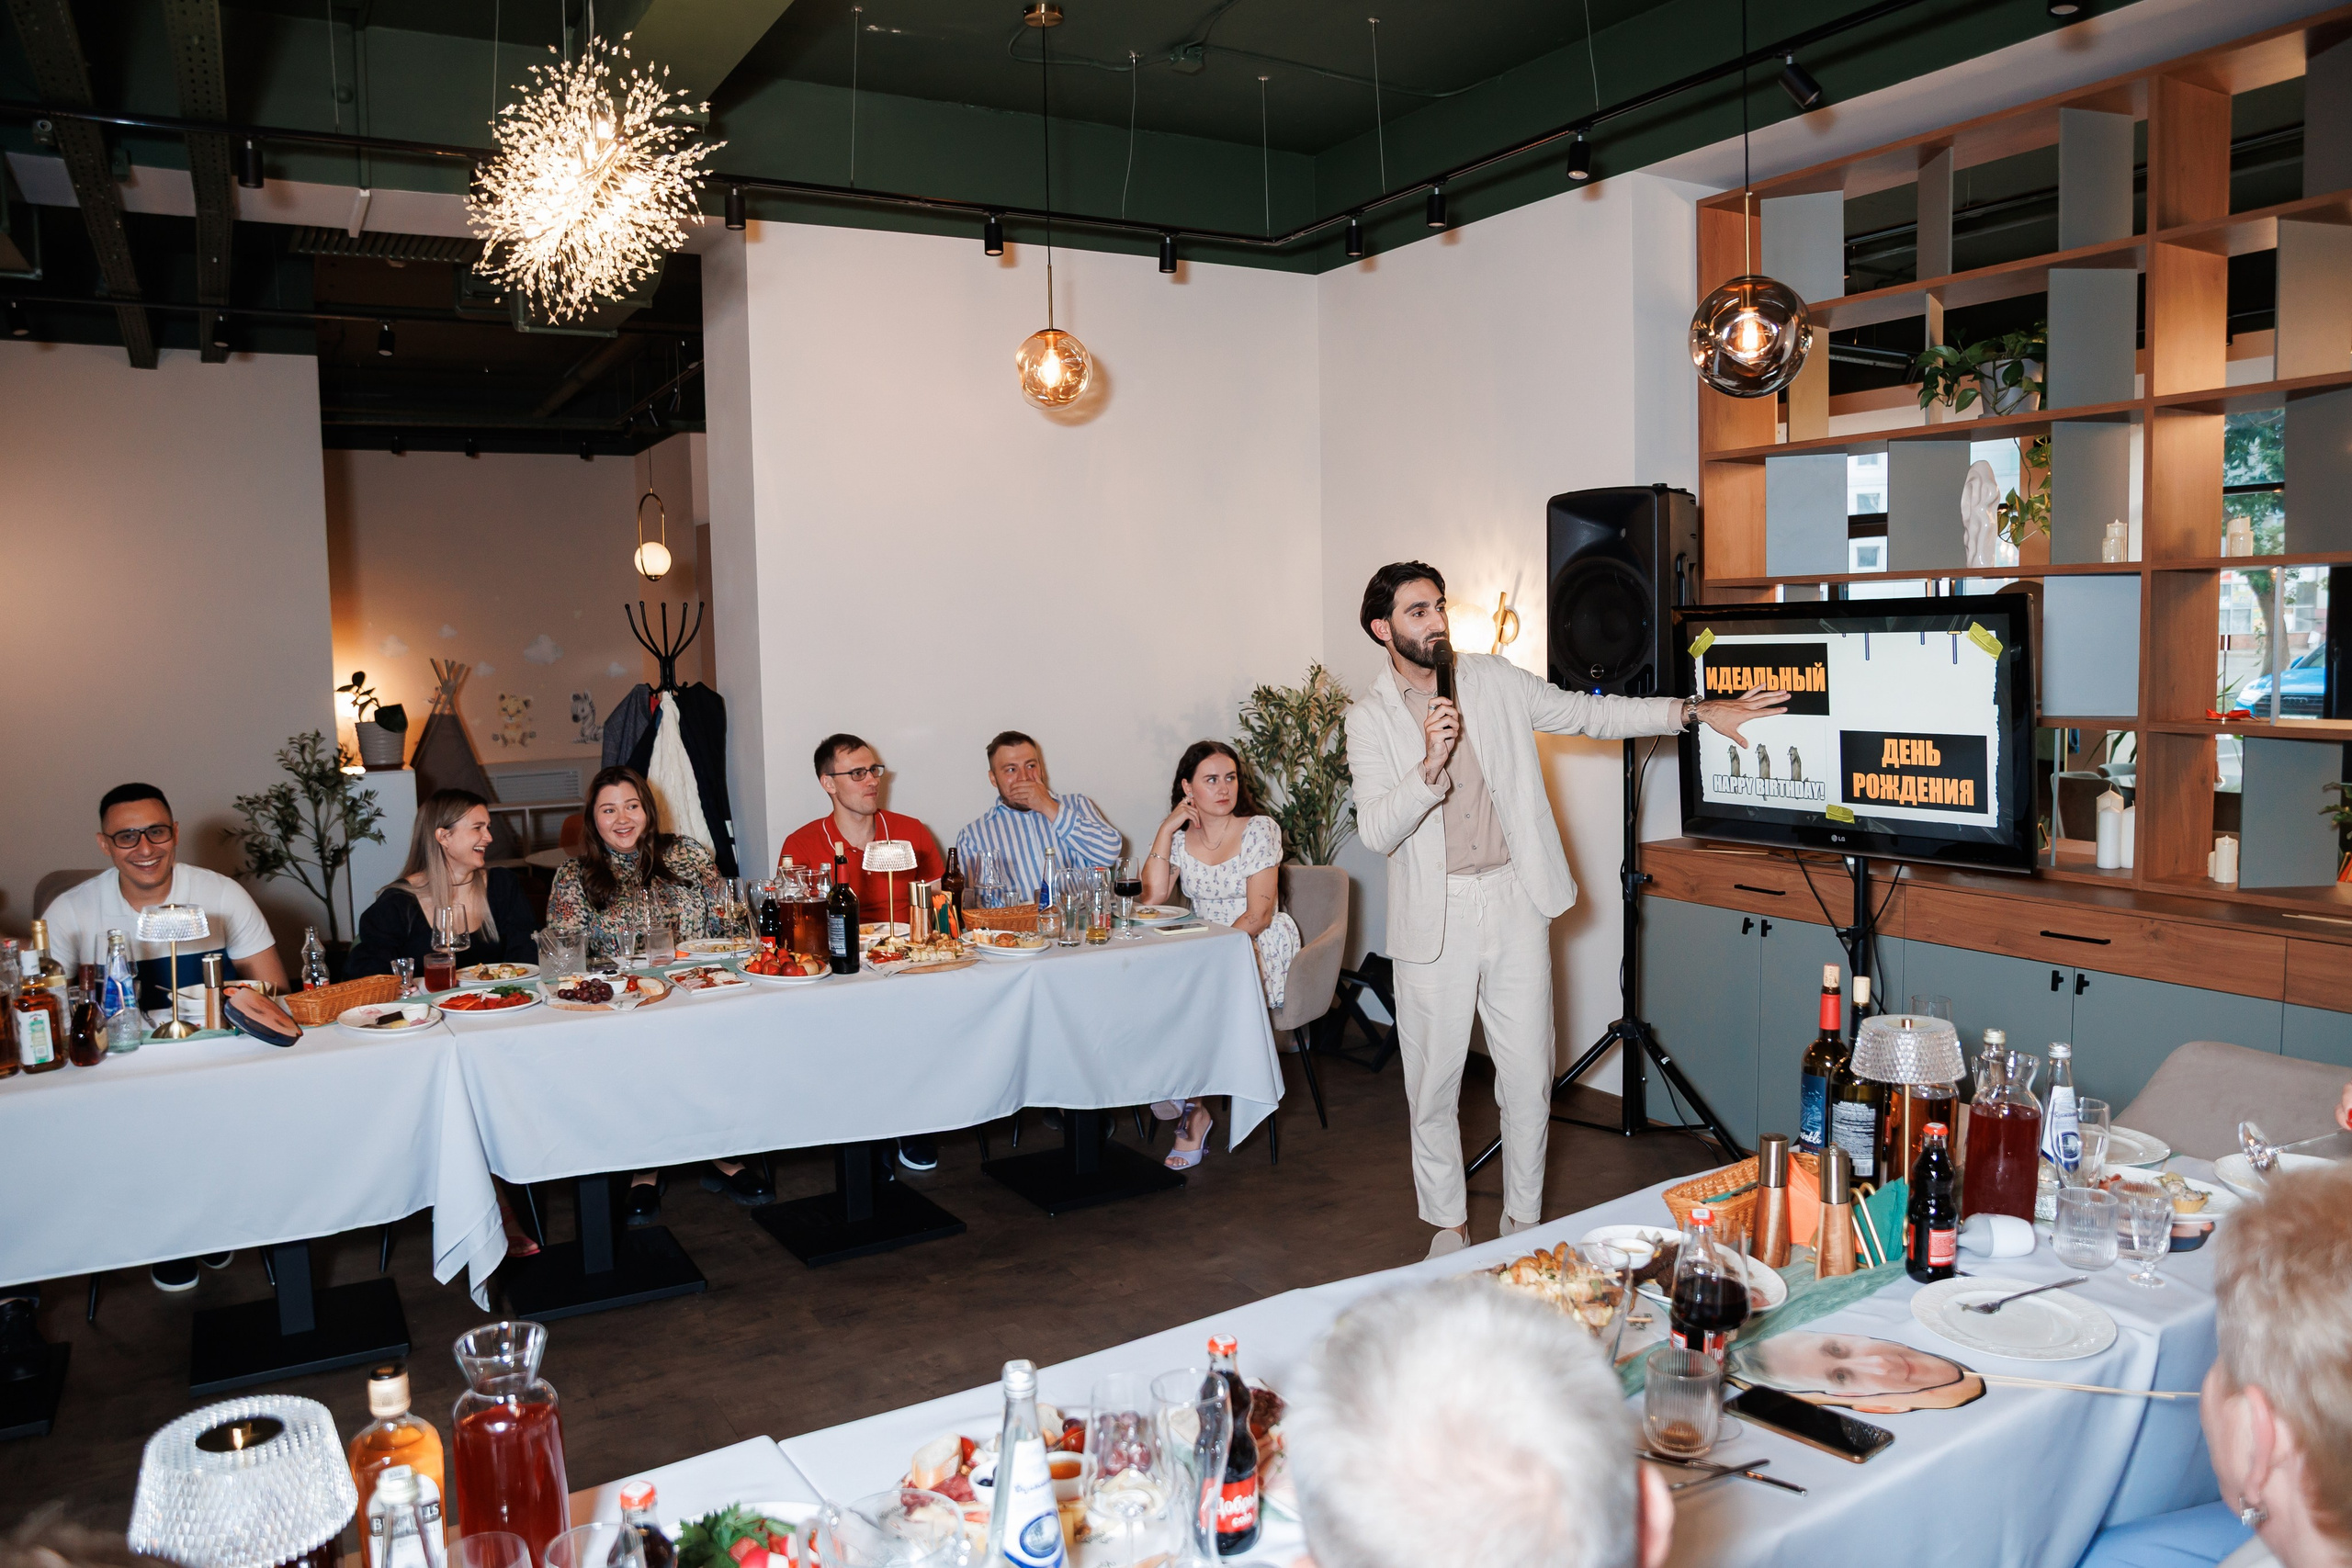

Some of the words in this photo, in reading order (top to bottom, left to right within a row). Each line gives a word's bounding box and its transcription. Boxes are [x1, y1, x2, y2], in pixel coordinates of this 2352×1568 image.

[1705, 661, 1826, 694] ИДЕАЛЬНЫЙ
[1882, 738, 1941, 769] ДЕНЬ
[1713, 774, 1754, 795] HAPPY
[1755, 777, 1826, 800] BIRTHDAY!
[1852, 772, 1975, 807] РОЖДЕНИЯ
